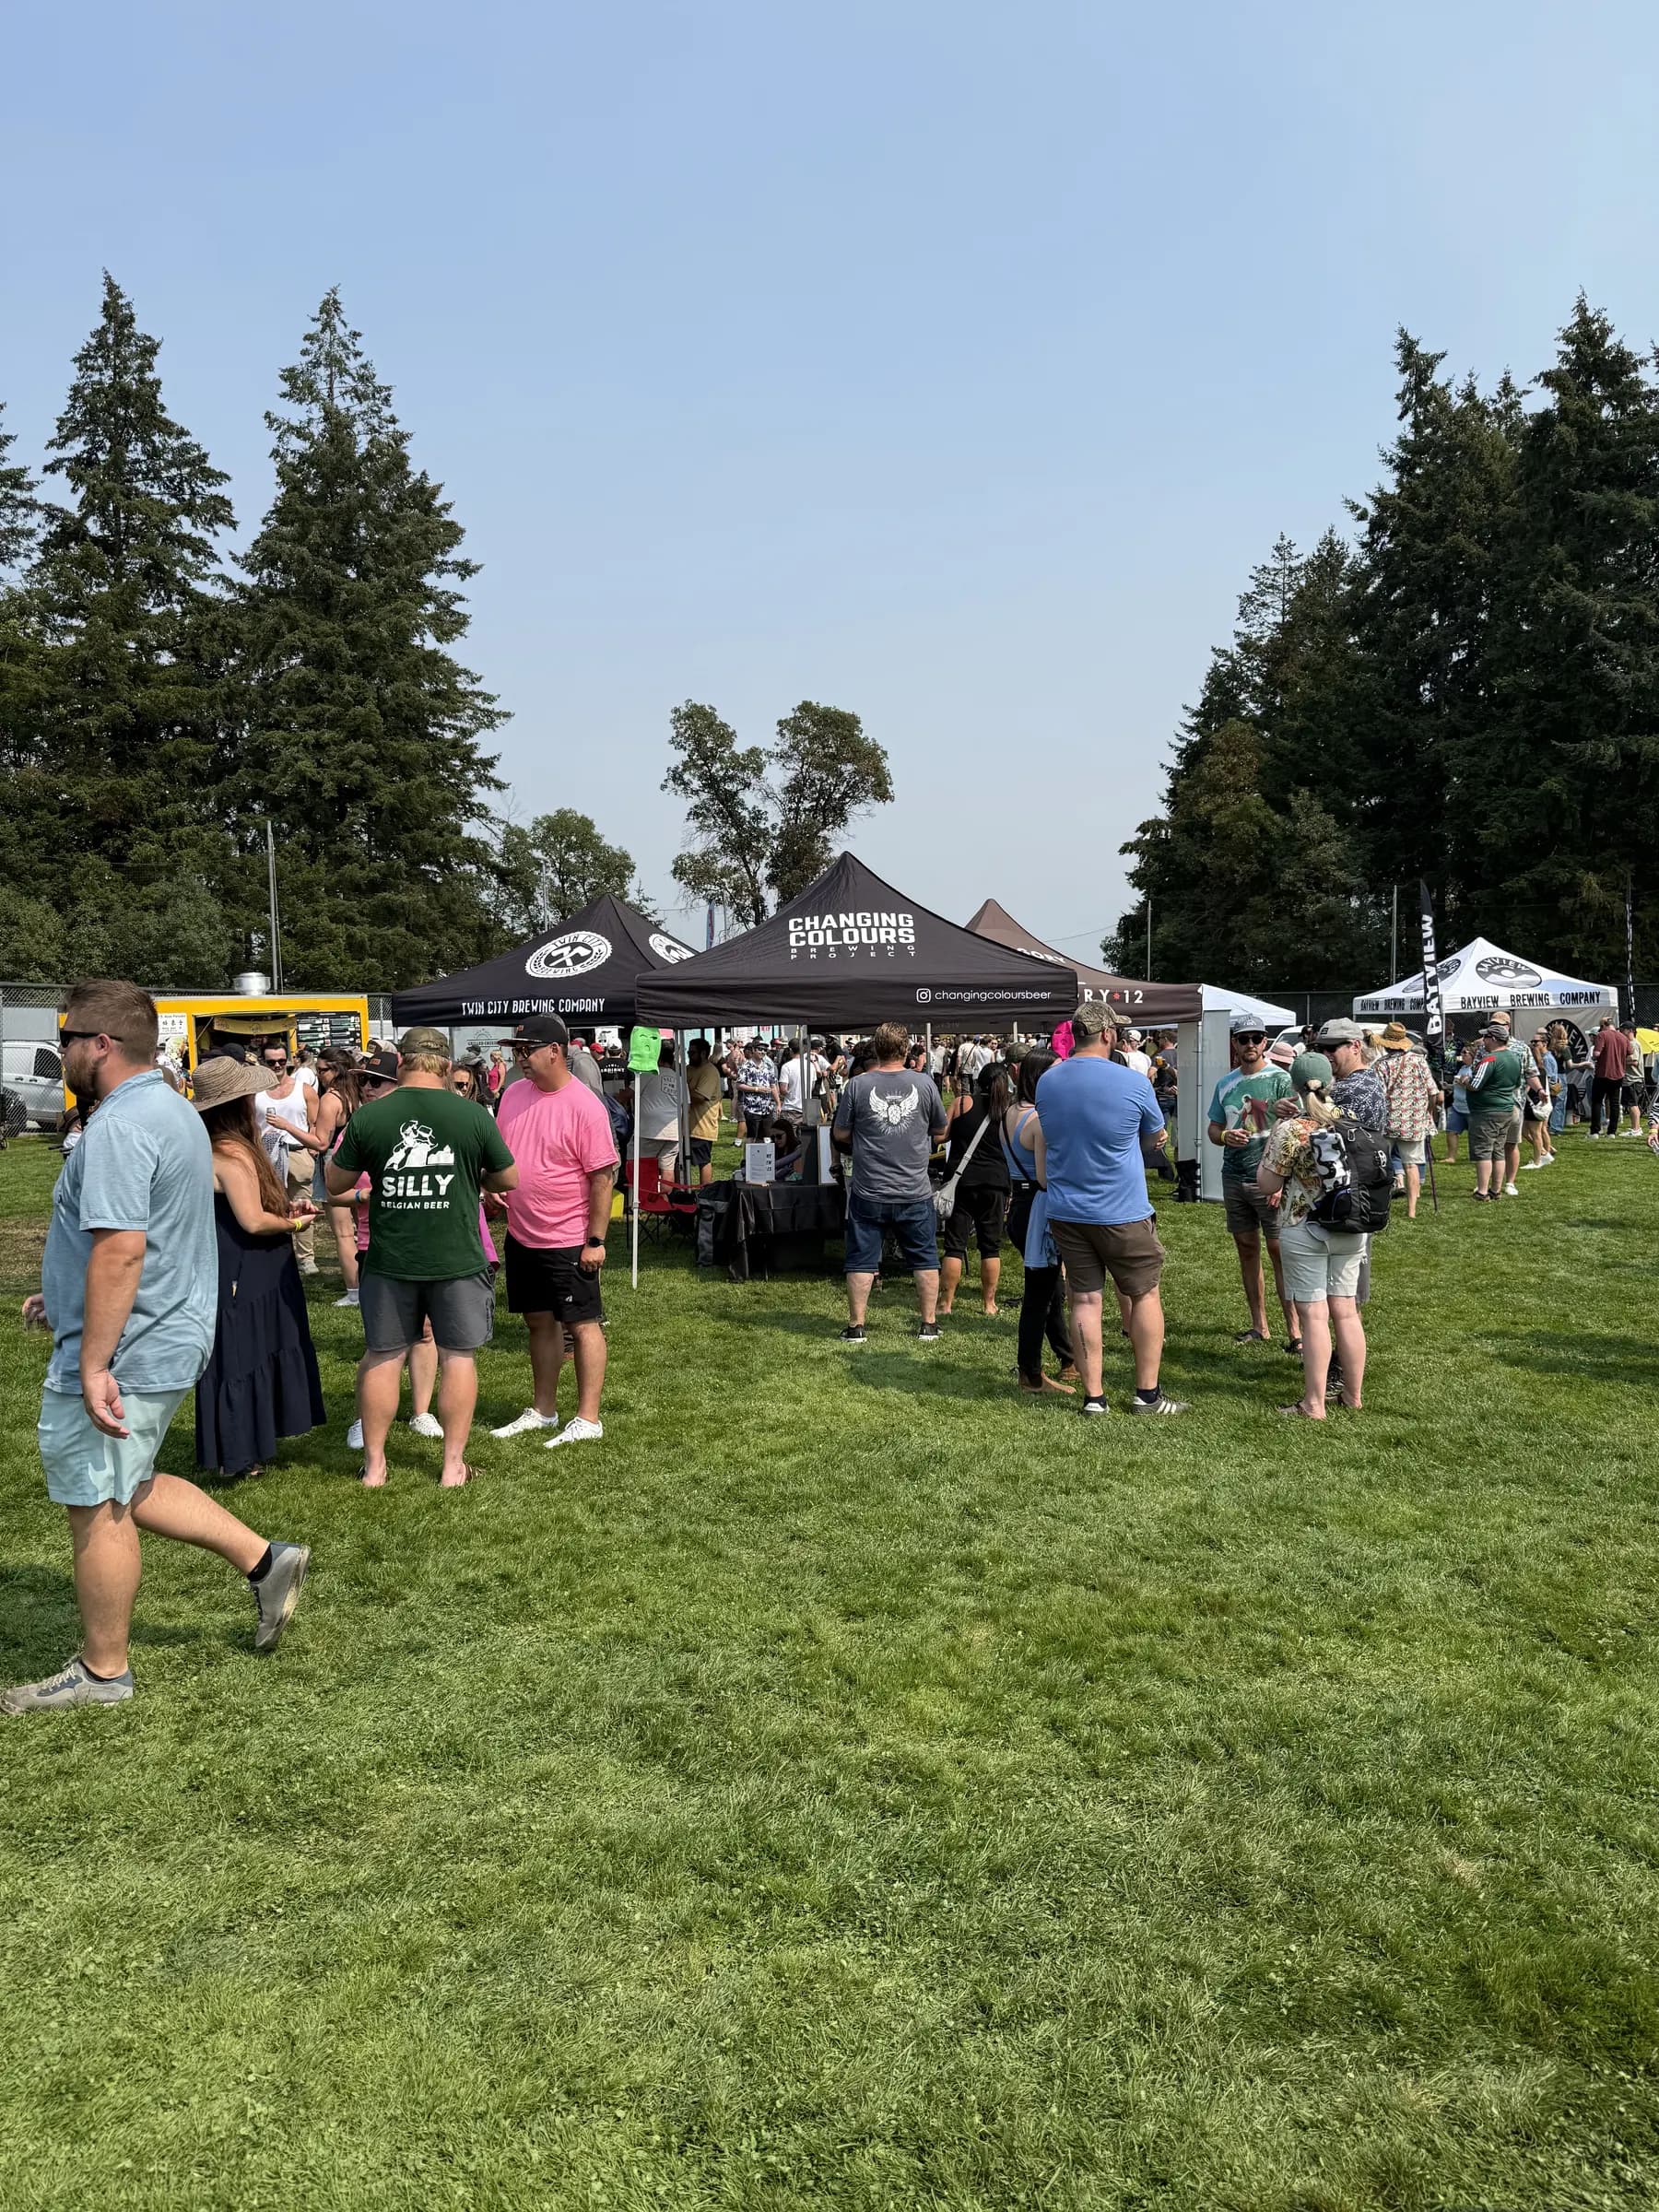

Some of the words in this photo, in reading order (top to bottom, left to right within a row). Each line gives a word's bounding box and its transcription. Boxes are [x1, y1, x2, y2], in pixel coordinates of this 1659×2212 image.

[788, 912, 914, 932] CHANGING
[789, 927, 916, 947] COLOURS
[791, 945, 915, 954] BREWING
[791, 951, 916, 960] PROJECT
[1477, 957, 1530, 973] BAYVIEW
[1422, 913, 1442, 1035] BAYVIEW
[935, 990, 1052, 1002] changingcoloursbeer
[1077, 988, 1110, 1003] RY
[1123, 990, 1144, 1004] 12
[1409, 997, 1425, 1011] COMP
[1460, 995, 1500, 1009] BAYVIEW
[1510, 993, 1550, 1007] BREWING
[1559, 991, 1601, 1005] COMPANY
[462, 1002, 485, 1015] TWIN
[487, 1000, 510, 1014] CITY
[512, 999, 555, 1013] BREWING
[559, 997, 606, 1012] COMPANY
[382, 1174, 454, 1197] SILLY
[381, 1201, 421, 1209] BELGIAN
[423, 1201, 451, 1209] BEER
